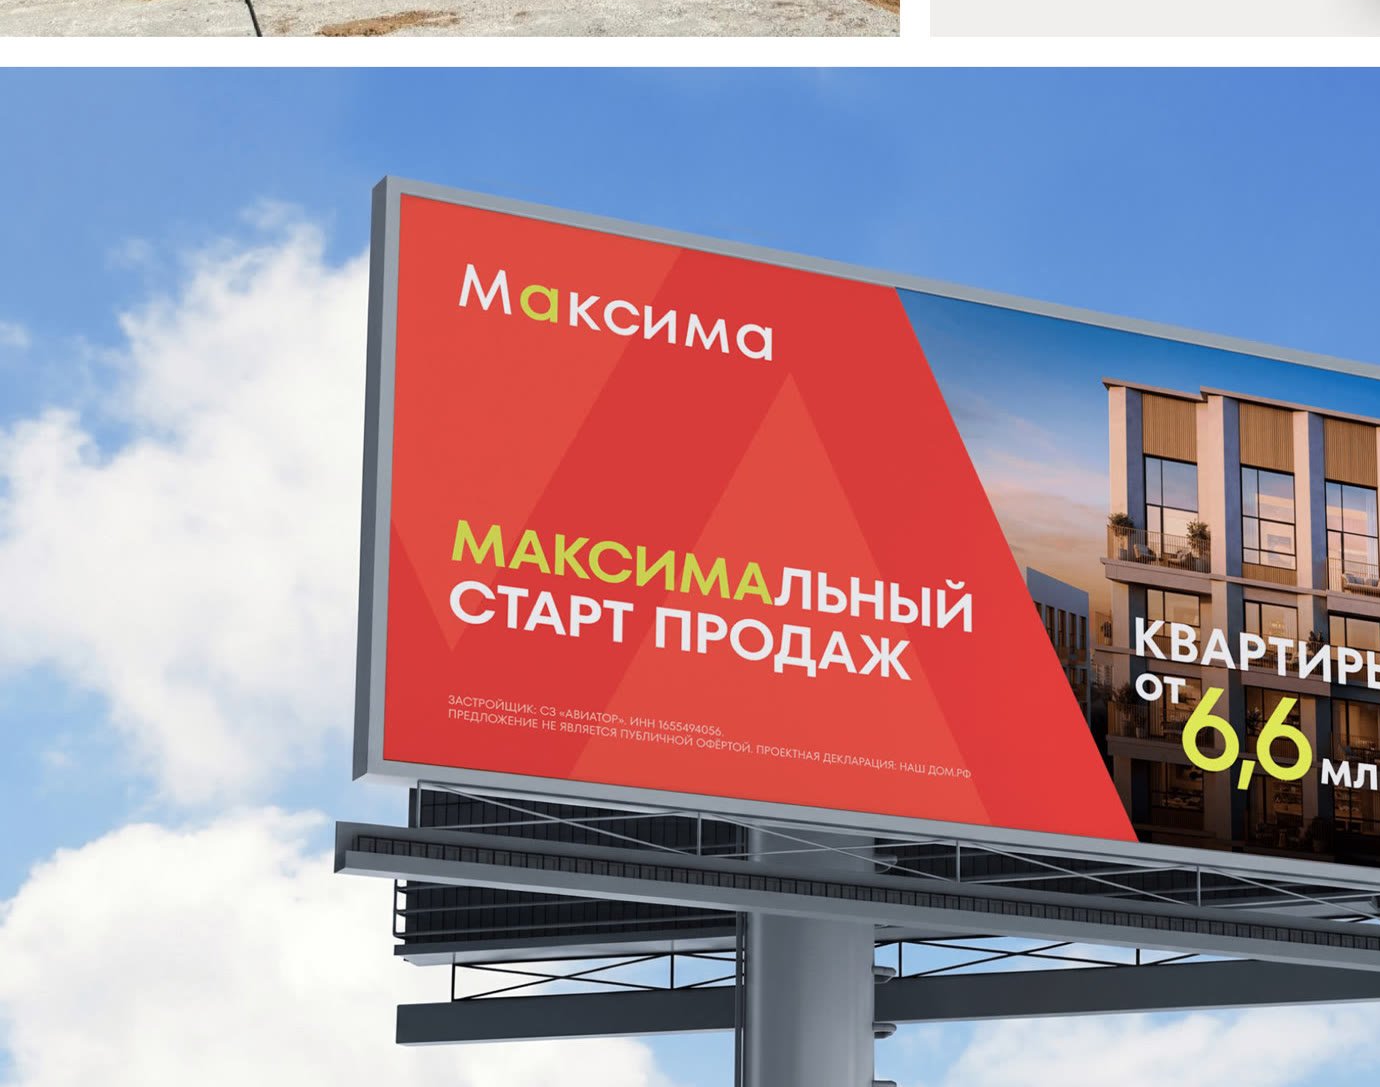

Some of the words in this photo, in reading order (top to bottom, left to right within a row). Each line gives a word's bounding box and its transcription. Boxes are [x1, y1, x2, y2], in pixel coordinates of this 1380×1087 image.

[459, 263, 773, 361] Максима
[451, 519, 973, 633] МАКСИМАЛЬНЫЙ
[449, 580, 634, 643] СТАРТ
[655, 606, 912, 681] ПРОДАЖ
[448, 708, 538, 729] ПРЕДЛОЖЕНИЕ
[542, 720, 556, 731] НЕ
[560, 722, 617, 738] ЯВЛЯЕТСЯ
[620, 728, 693, 747] ПУБЛИЧНОЙ
[756, 744, 820, 762] ПРОЕКТНАЯ
[822, 752, 897, 771] ДЕКЛАРАЦИЯ:
[899, 762, 925, 774] НАШ
[927, 765, 972, 779] ДОМ.РФ
[629, 716, 655, 728] ИНН
[1181, 686, 1313, 790] 6,6
